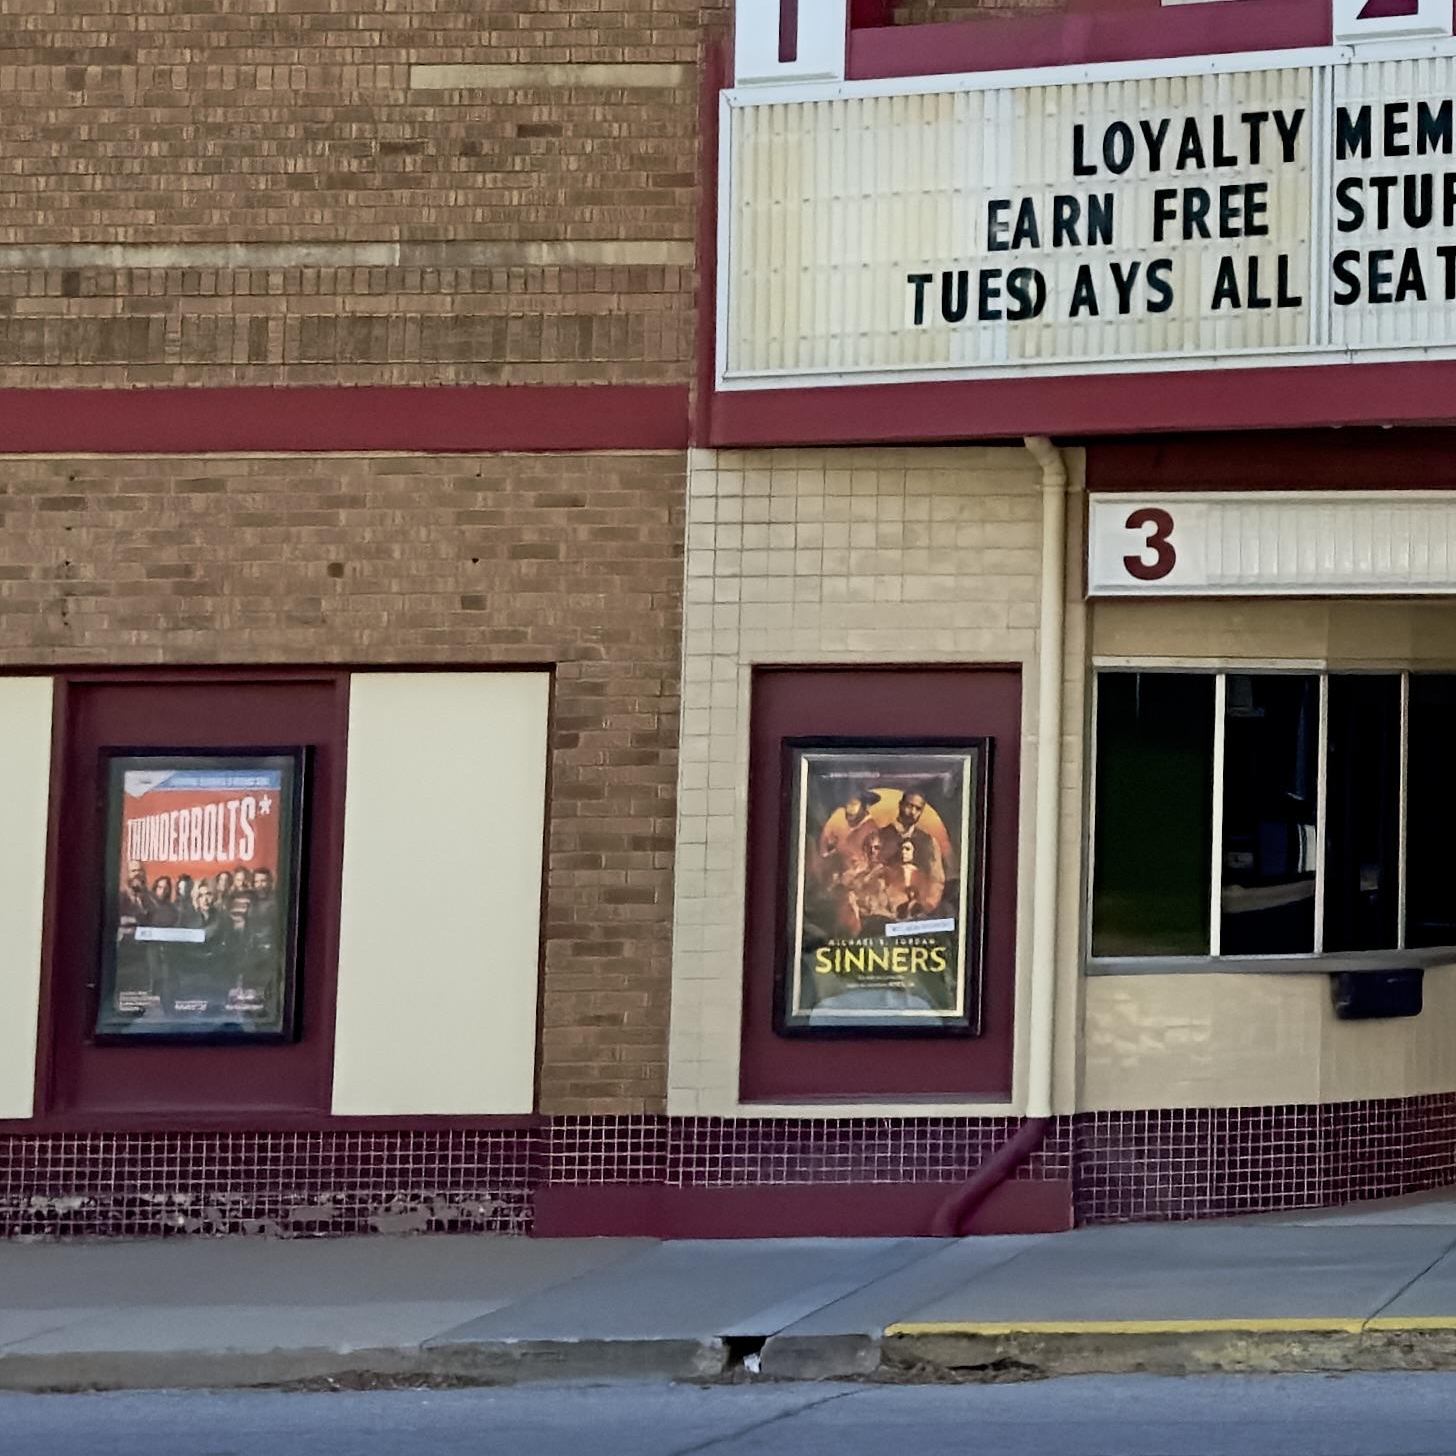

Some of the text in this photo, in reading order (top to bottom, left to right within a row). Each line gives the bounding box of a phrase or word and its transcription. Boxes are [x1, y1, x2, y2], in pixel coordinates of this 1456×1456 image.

[1072, 108, 1306, 176] LOYALTY
[986, 193, 1115, 252] EARN
[1153, 182, 1270, 242] FREE
[1210, 254, 1303, 311] ALL
[1122, 507, 1177, 581] 3
[815, 946, 947, 974] SINNERS
